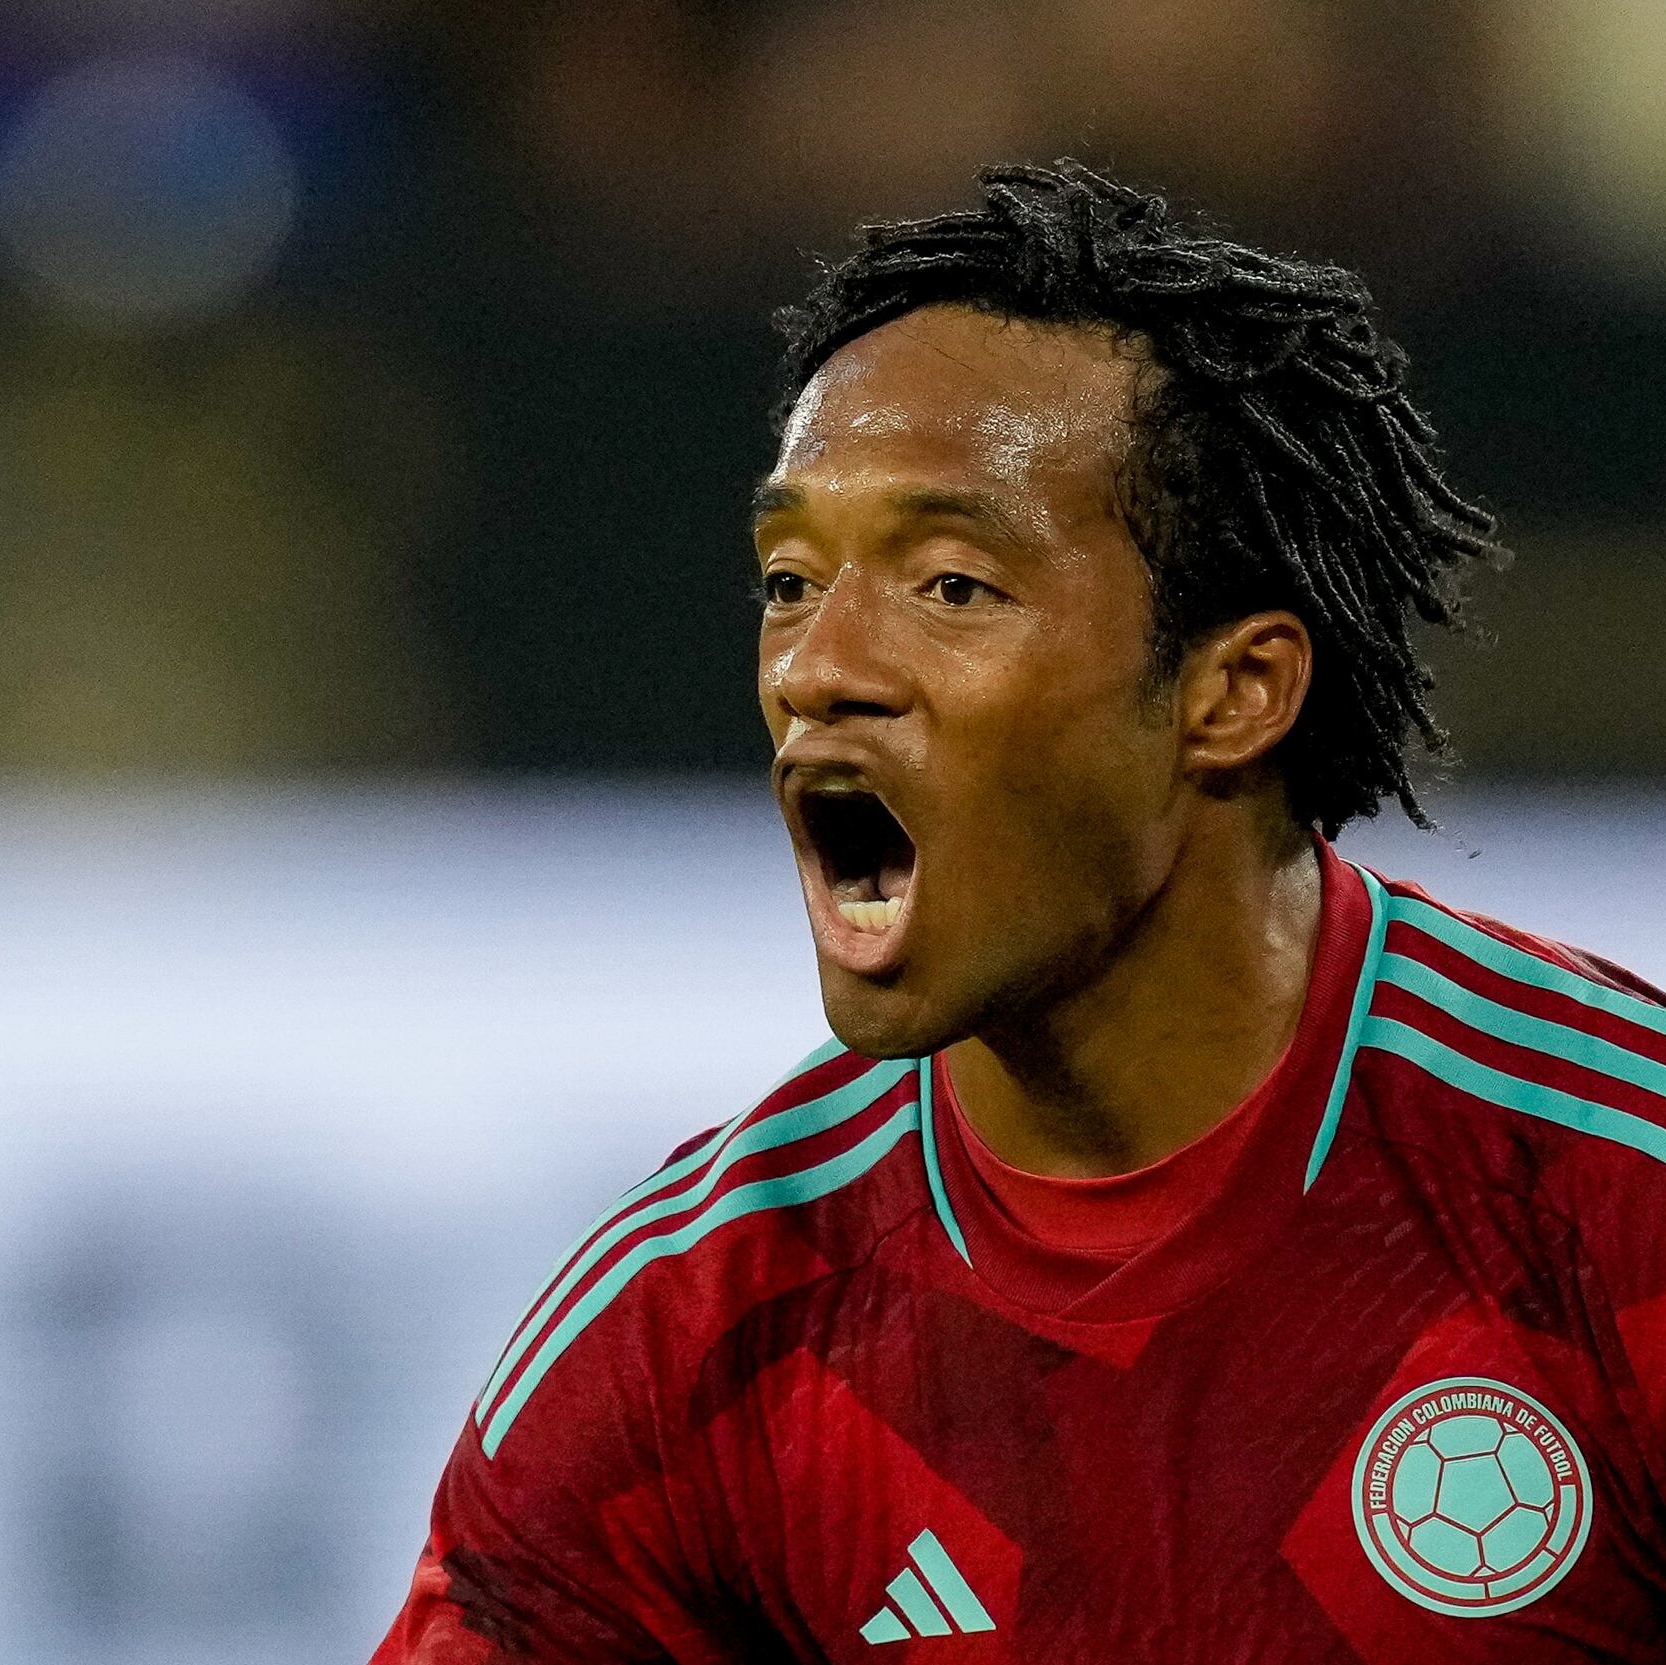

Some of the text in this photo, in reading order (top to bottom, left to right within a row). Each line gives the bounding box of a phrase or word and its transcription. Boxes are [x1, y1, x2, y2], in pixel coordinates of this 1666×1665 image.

[1370, 1392, 1573, 1510] FEDERACION COLOMBIANA DE FUTBOL
